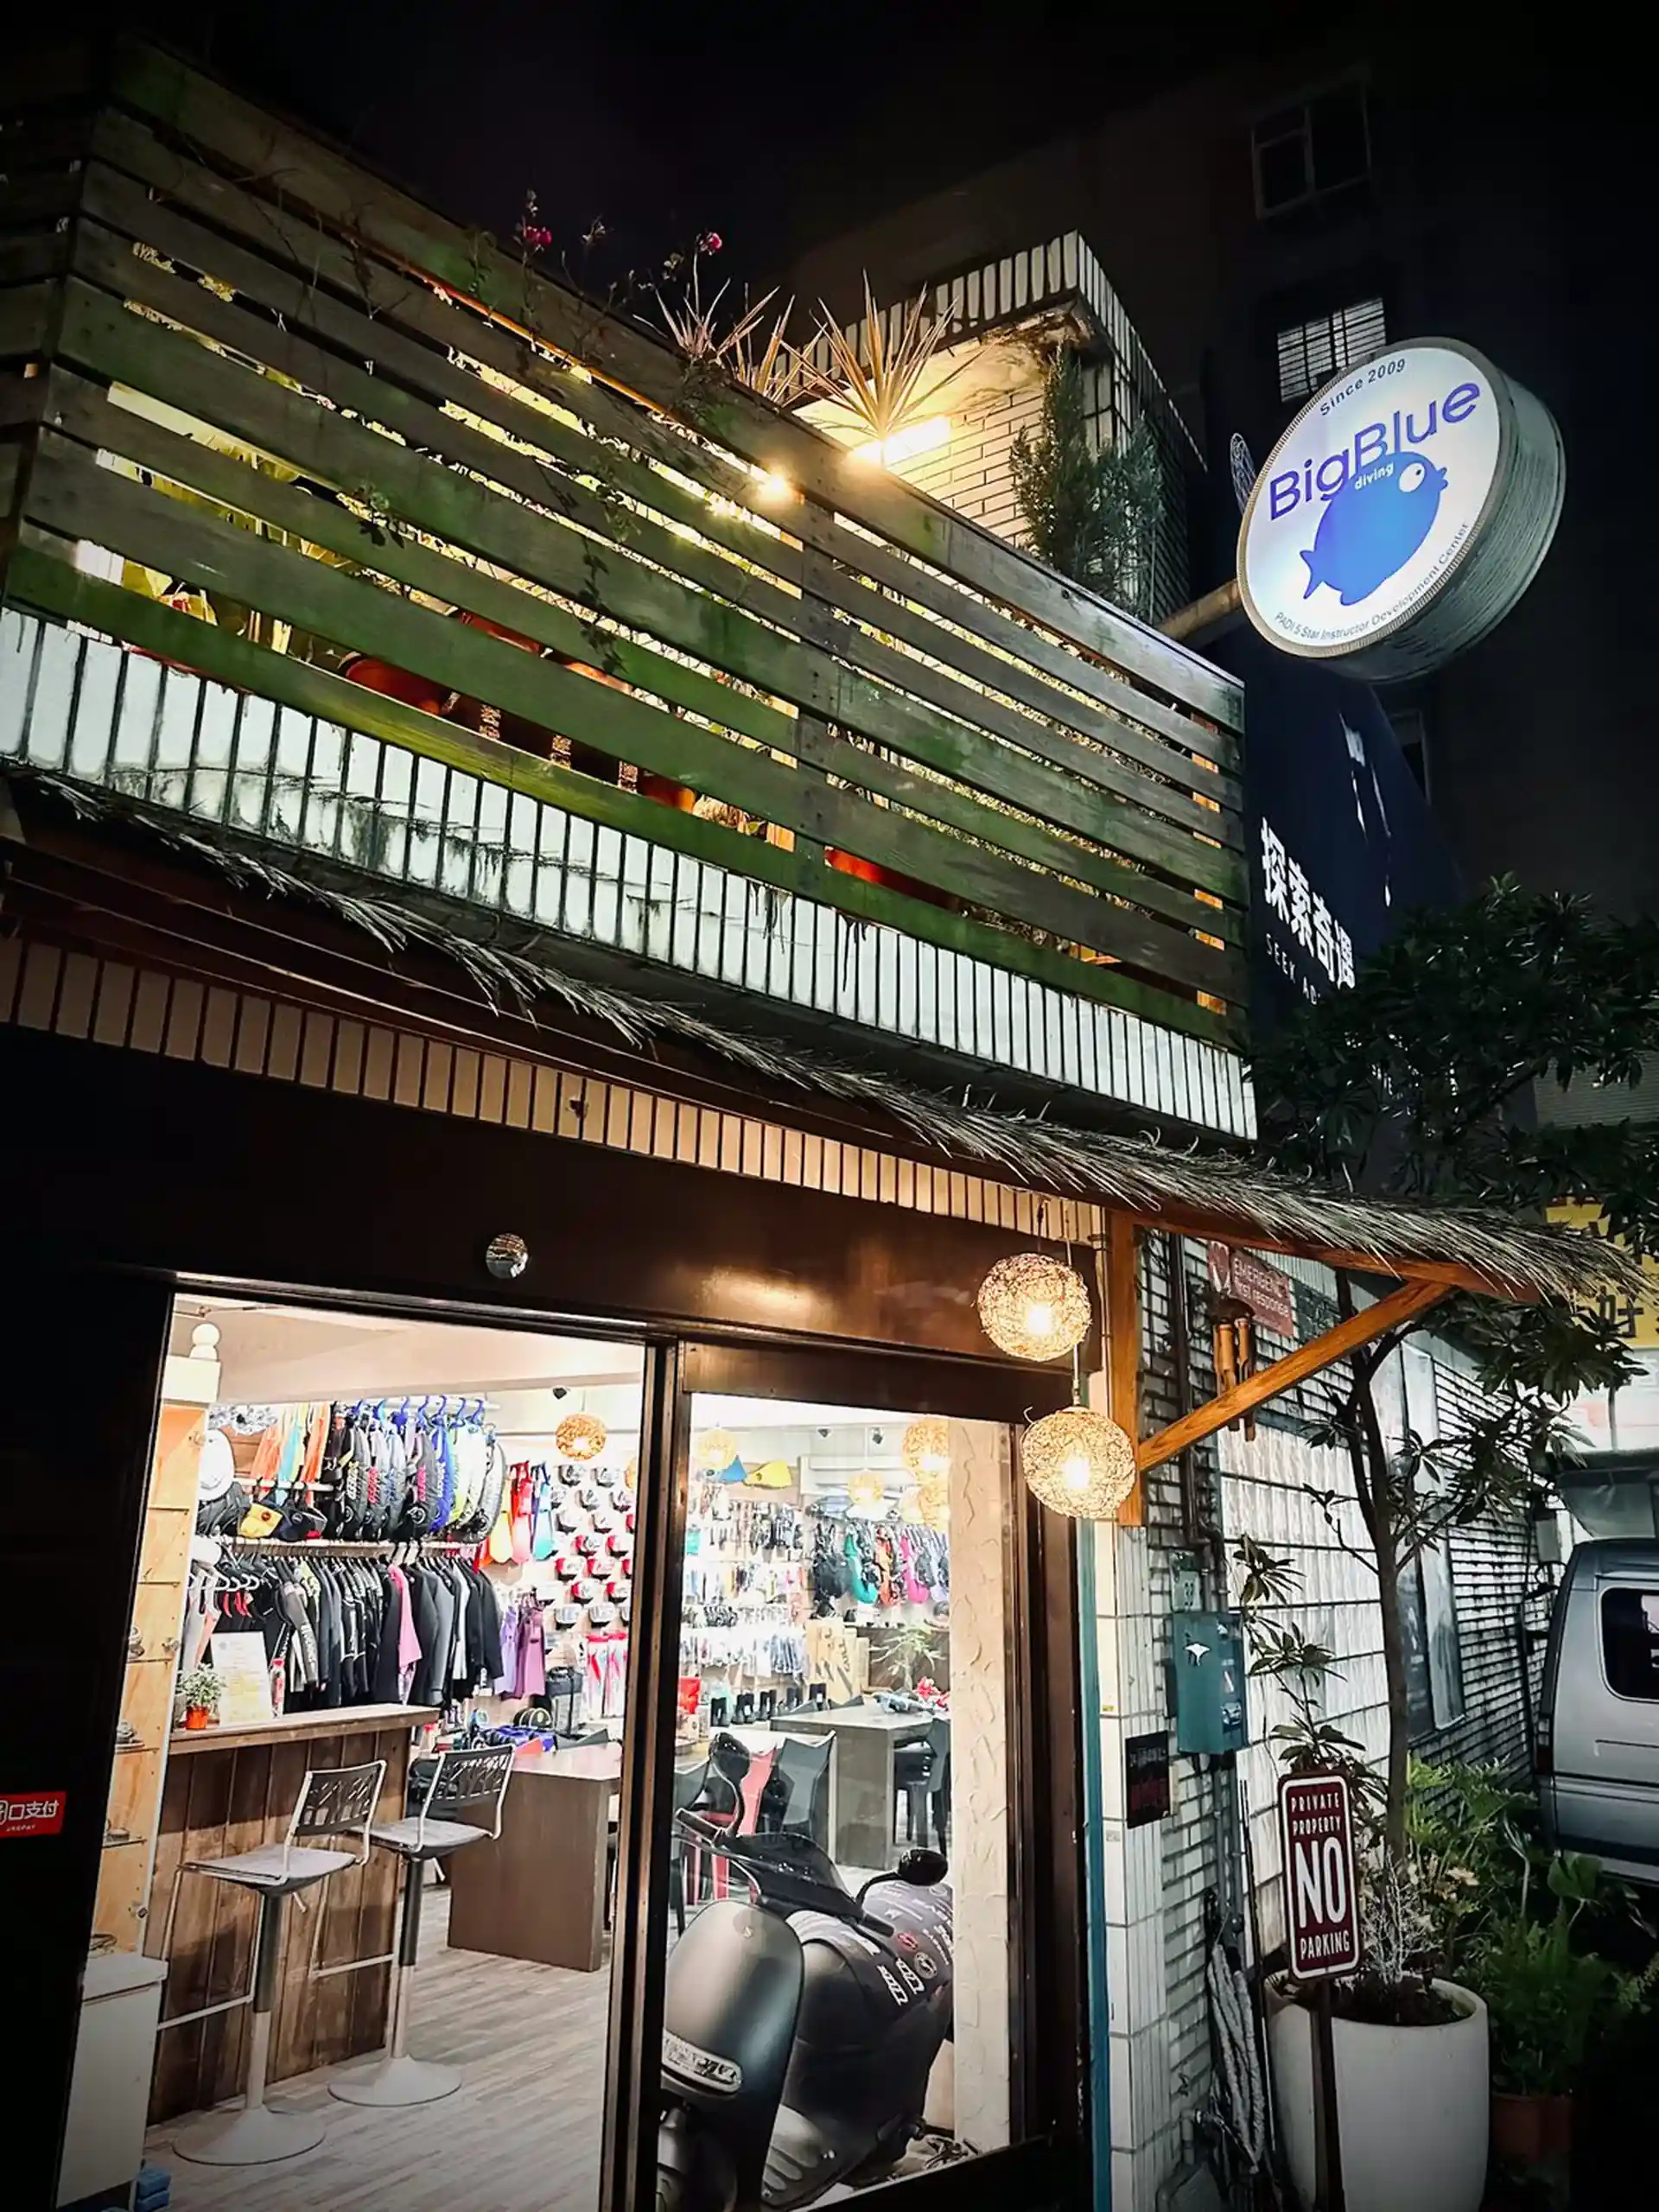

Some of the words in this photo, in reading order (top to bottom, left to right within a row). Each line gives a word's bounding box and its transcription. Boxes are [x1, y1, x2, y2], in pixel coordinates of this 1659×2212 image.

[1320, 378, 1363, 416] Since
[1368, 359, 1406, 384] 2009
[1354, 461, 1394, 490] diving
[1275, 612, 1294, 631] PADI
[1300, 626, 1320, 640] Star
[1319, 620, 1370, 640] Instructor
[1371, 565, 1440, 626] Development
[1438, 523, 1469, 565] Center
[1291, 1792, 1339, 1813] PRIVATE
[1293, 1815, 1341, 1836] PROPERTY
[1294, 1836, 1346, 1929] NO
[1300, 1929, 1351, 1961] PARKING
